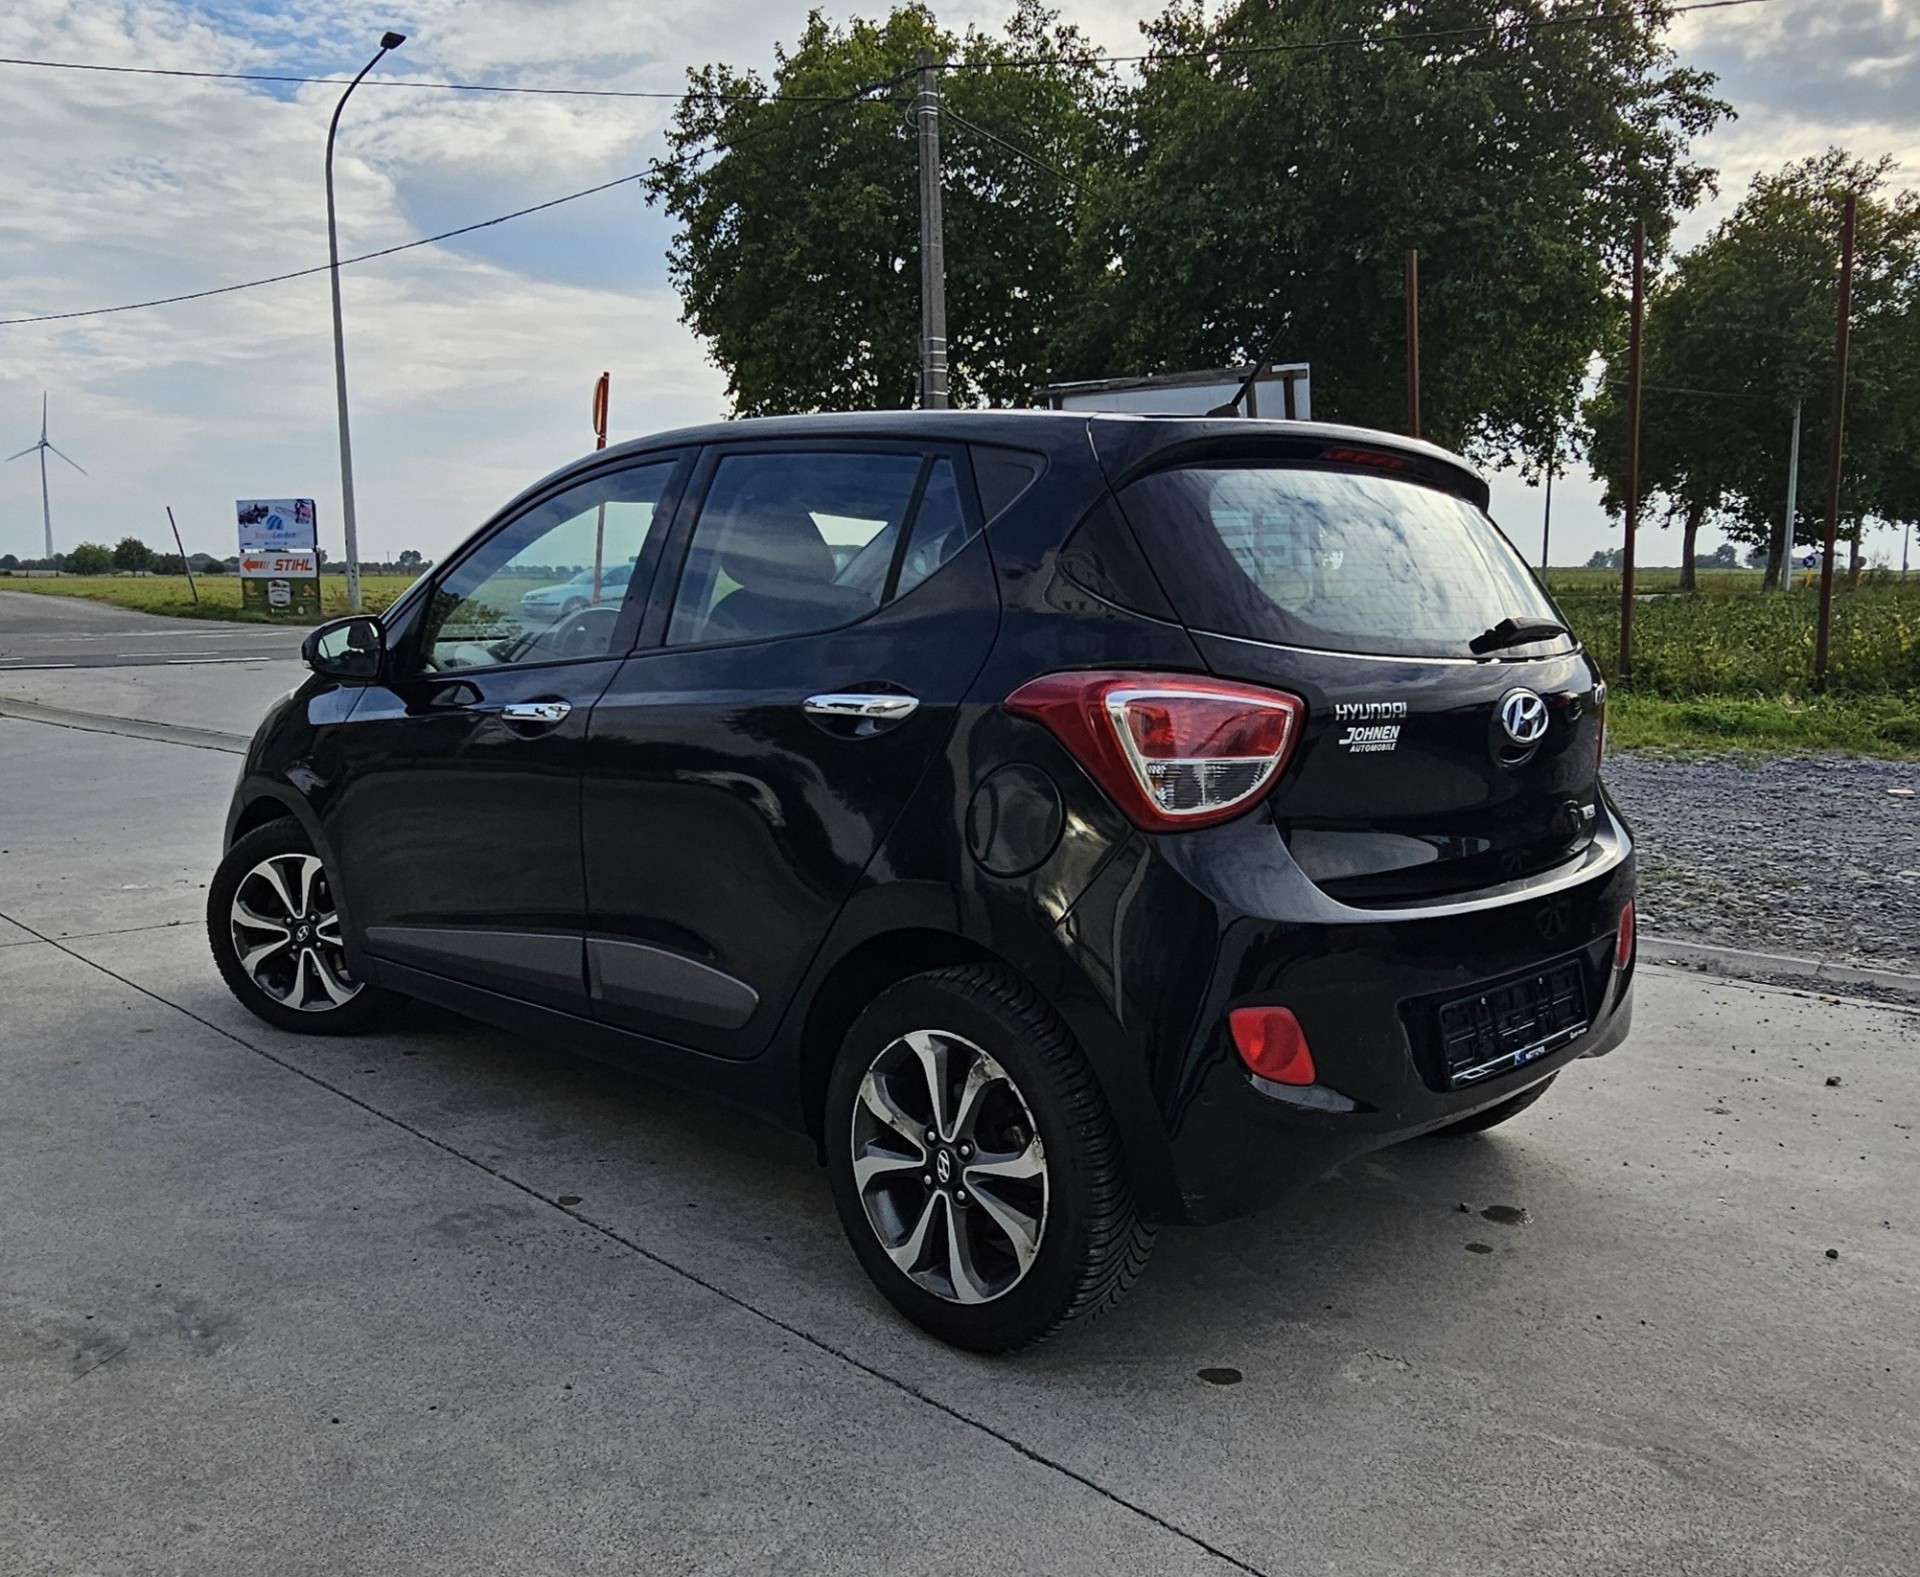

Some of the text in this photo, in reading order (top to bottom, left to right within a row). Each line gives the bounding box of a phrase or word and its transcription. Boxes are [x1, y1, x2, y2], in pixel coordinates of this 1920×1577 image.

[274, 559, 312, 571] STIHL
[1335, 702, 1407, 720] HYUNDAI
[1338, 726, 1401, 745] JOHNEN
[1349, 743, 1396, 753] AUTOMOBILE
